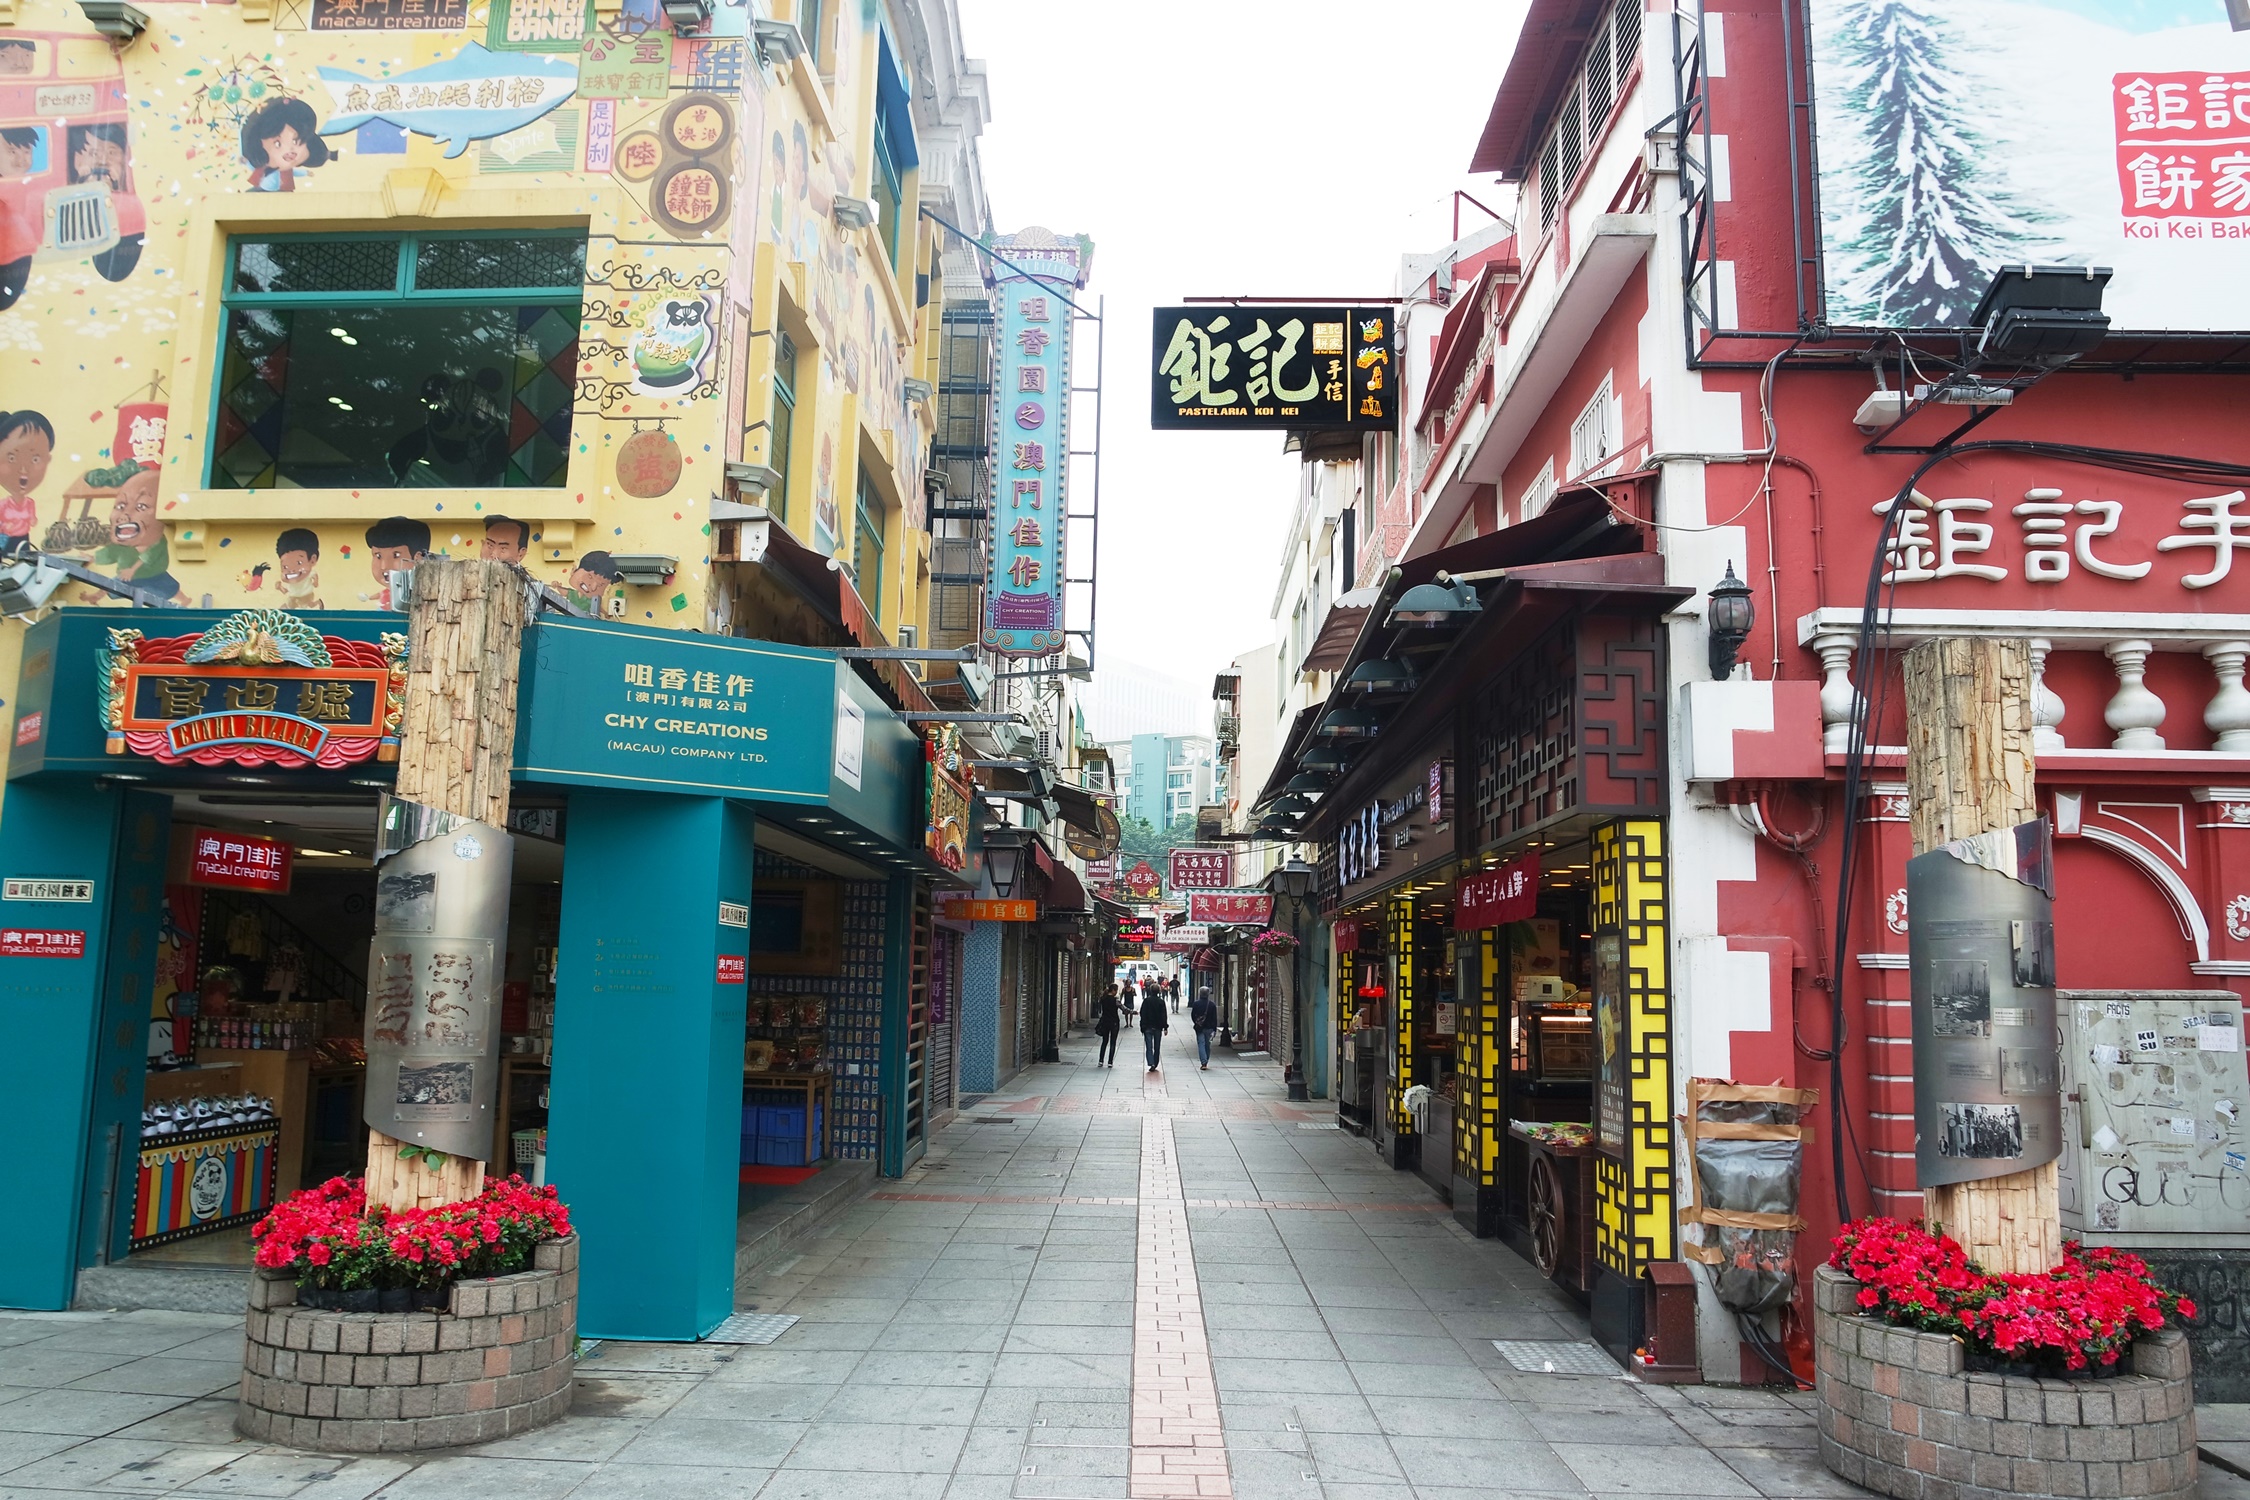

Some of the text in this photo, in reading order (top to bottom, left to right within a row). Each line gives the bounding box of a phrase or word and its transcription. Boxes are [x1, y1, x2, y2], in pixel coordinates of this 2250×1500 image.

[319, 16, 465, 28] macau creations
[506, 16, 583, 41] BANG!
[583, 37, 665, 64] 公主
[584, 72, 665, 91] 珠寶金行
[2120, 76, 2250, 131] 鉅記
[499, 129, 546, 154] Sprite
[625, 140, 657, 169] 陸
[2126, 151, 2250, 211] 餅家
[2123, 222, 2160, 239] Koi
[2168, 222, 2203, 239] Kei
[629, 285, 699, 328] Soda Panda
[1159, 315, 1320, 407] 鉅記
[1323, 359, 1344, 402] 手信
[1178, 407, 1299, 417] PASTELARIA KOI KEI
[1008, 296, 1051, 587] 咀香園之澳門佳作
[624, 662, 755, 699] 咀香佳作
[179, 715, 313, 749] CUNHA BAZAAR
[604, 712, 769, 742] CHY CREATIONS
[607, 739, 769, 764] (MACAU) COMPANY LTD.
[199, 837, 282, 869] 澳門佳作
[1196, 896, 1268, 912] 澳門郵票
[3, 931, 82, 947] 澳門佳作
[2138, 1031, 2155, 1040] KU
[2140, 1041, 2157, 1051] SU
